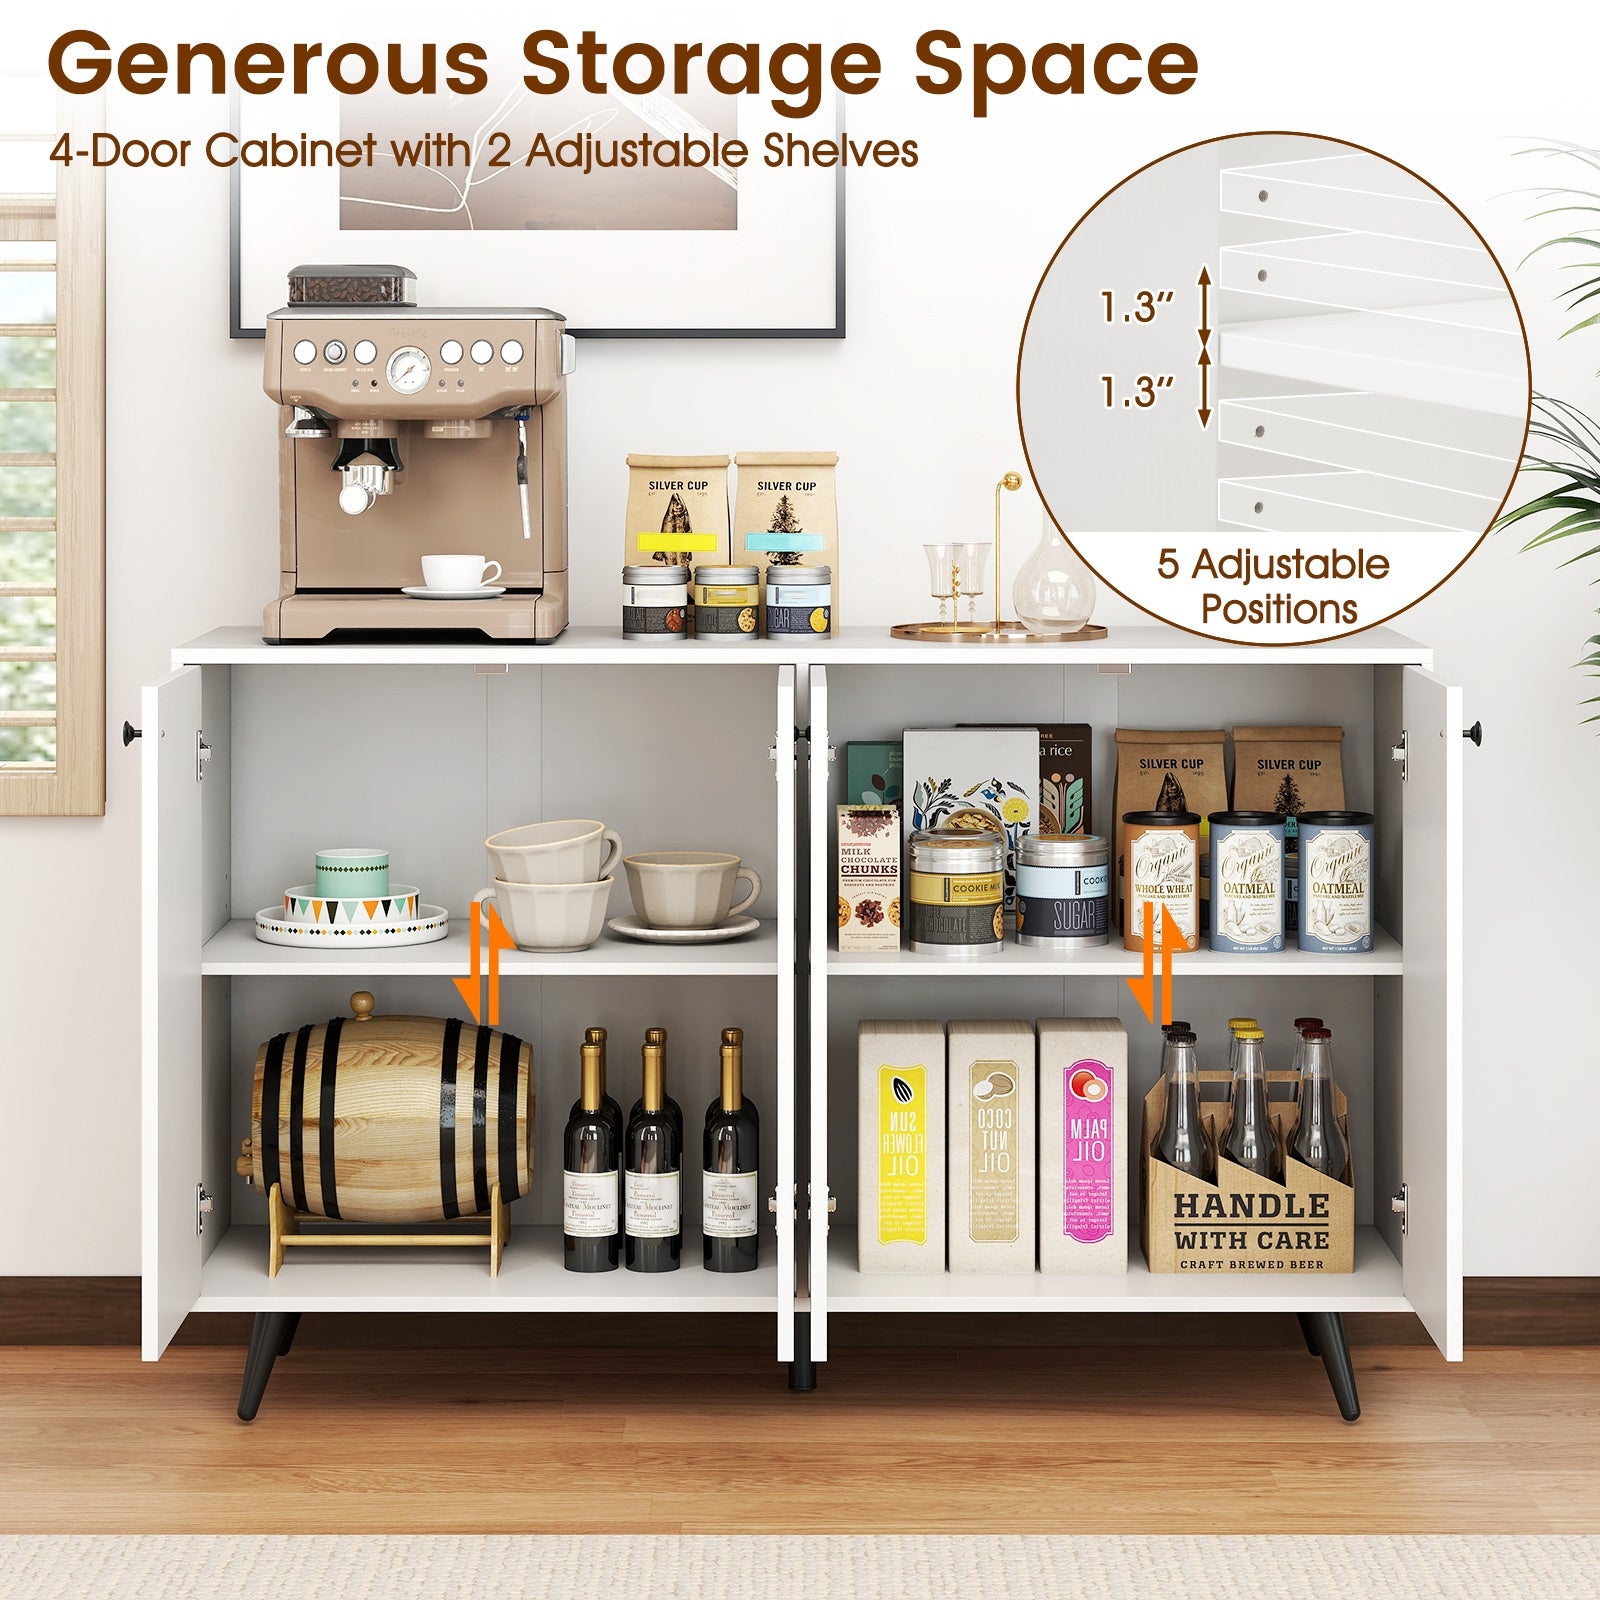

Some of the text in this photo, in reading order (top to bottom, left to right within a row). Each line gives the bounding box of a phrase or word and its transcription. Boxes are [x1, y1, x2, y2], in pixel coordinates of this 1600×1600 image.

[649, 481, 708, 490] SILVER CUP
[758, 482, 816, 490] SILVER CUP
[1050, 744, 1072, 756] rice
[1140, 758, 1204, 769] SILVER CUP
[1258, 759, 1322, 770] SILVER CUP
[1135, 843, 1188, 883] Organic
[1222, 843, 1274, 881] Organic
[1310, 843, 1362, 881] Organic
[841, 865, 898, 874] CHUNKS
[953, 884, 988, 892] COOKIE
[1135, 884, 1193, 894] WHOLE WHEAT
[1223, 882, 1276, 894] OATMEAL
[1312, 882, 1364, 894] OATMEAL
[1054, 900, 1095, 930] SUGAR
[1174, 1194, 1329, 1218] HANDLE
[1174, 1232, 1329, 1249] WITH CARE
[1180, 1260, 1324, 1269] CRAFT BREWED BEER
